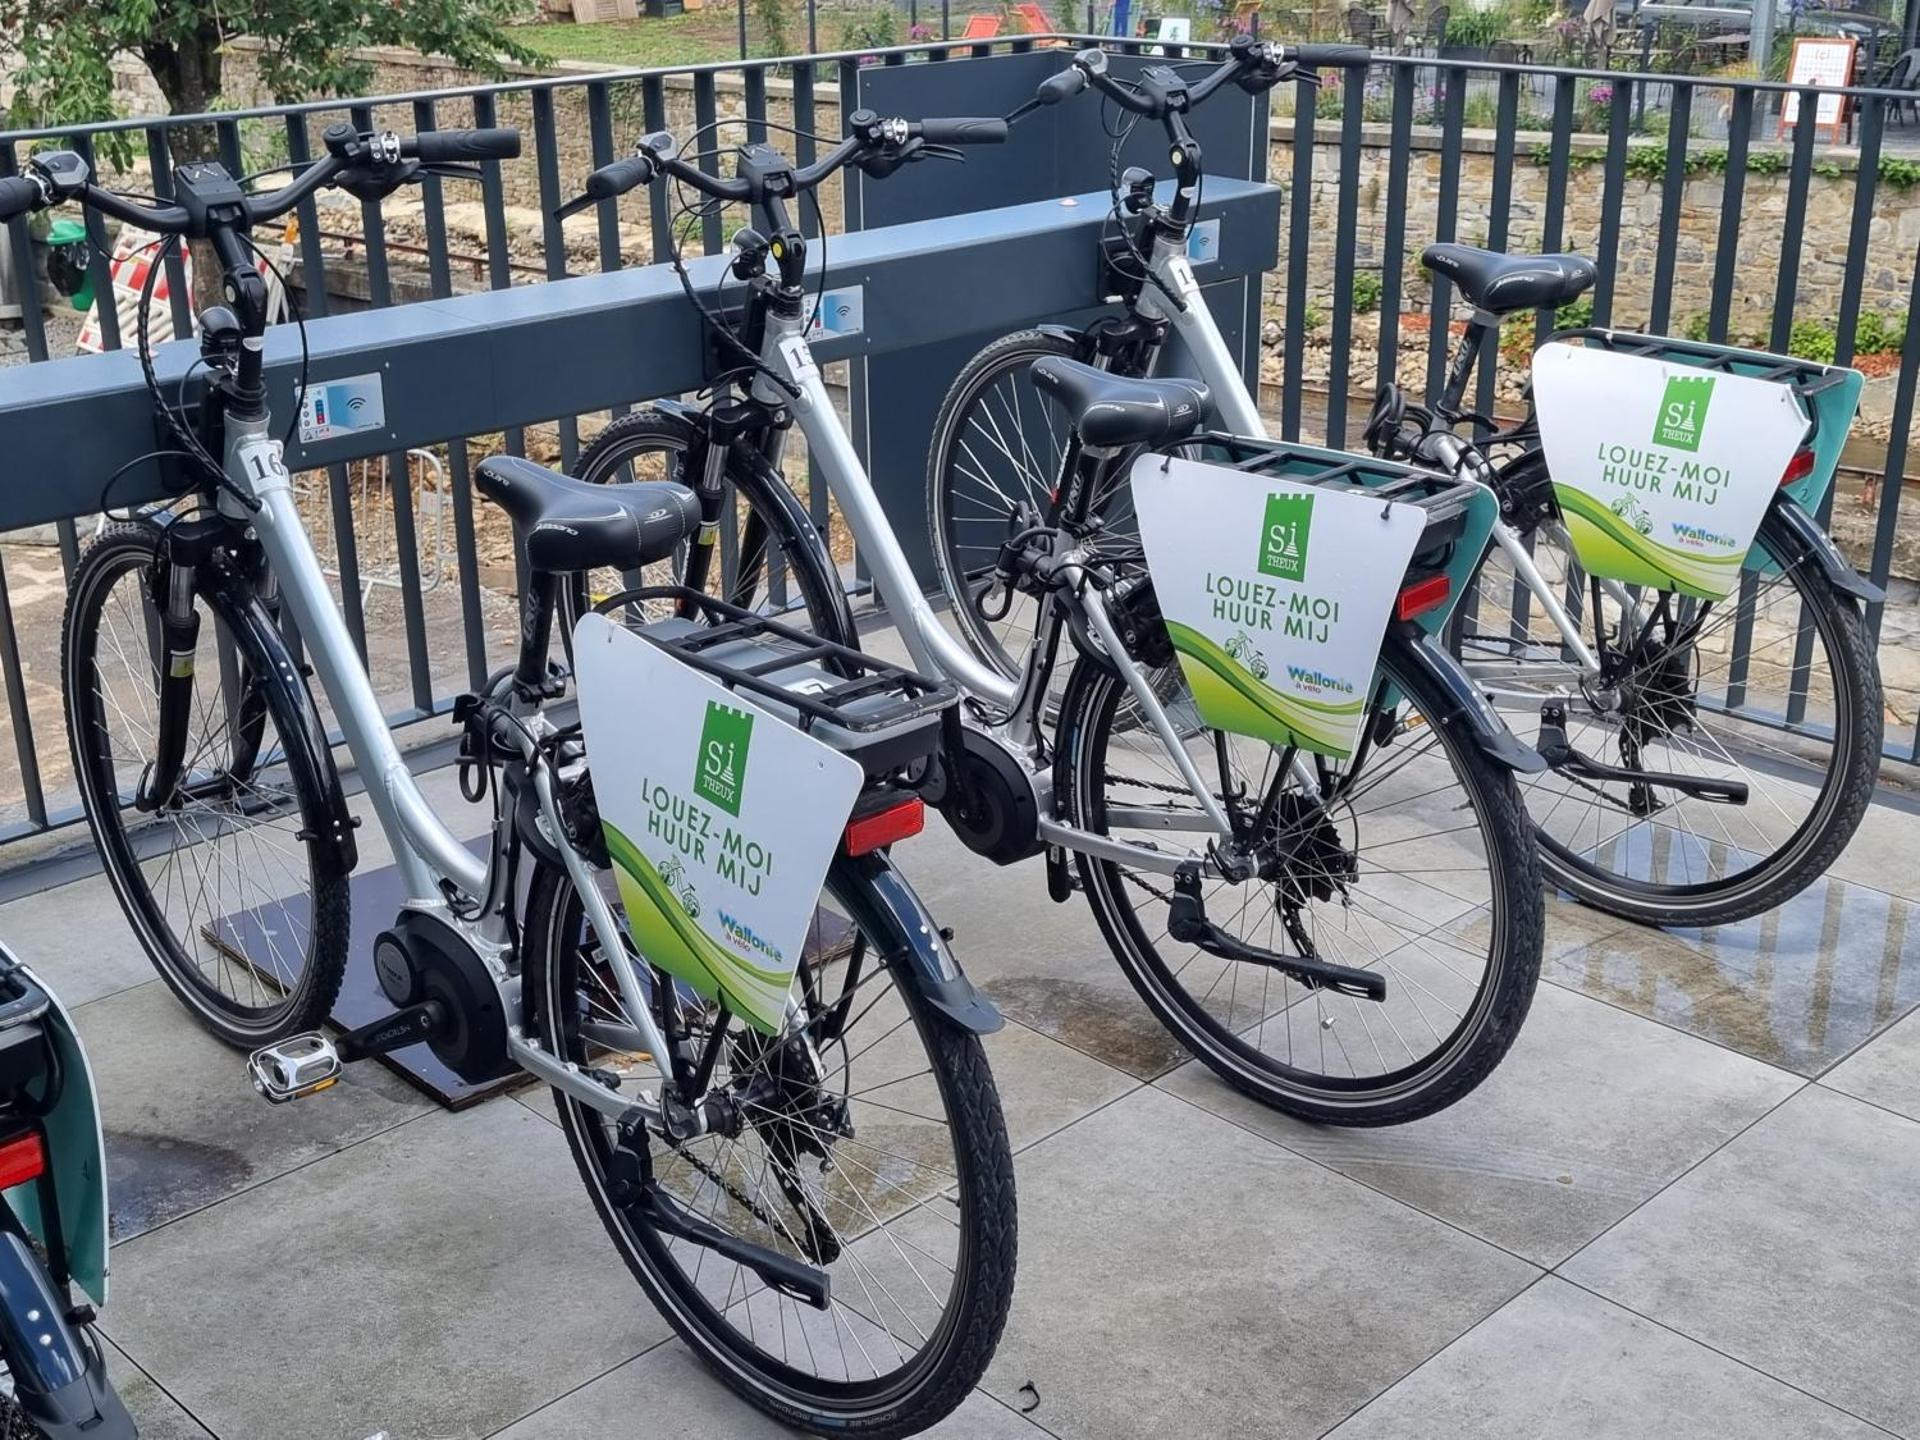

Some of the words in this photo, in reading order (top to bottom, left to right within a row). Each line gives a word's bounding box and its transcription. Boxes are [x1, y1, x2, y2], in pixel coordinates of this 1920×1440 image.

[1662, 427, 1694, 444] THEUX
[250, 453, 284, 480] 16
[1598, 442, 1730, 488] LOUEZ-MOI
[1602, 465, 1661, 493] HUUR
[1672, 481, 1717, 505] MIJ
[1672, 522, 1736, 548] Wallonie
[1267, 555, 1299, 572] THEUX
[1206, 573, 1339, 622] LOUEZ-MOI
[1213, 598, 1272, 630] HUUR
[1284, 616, 1328, 643] MIJ
[1287, 664, 1353, 694] Wallonie
[703, 774, 735, 803] THEUX
[642, 777, 772, 877] LOUEZ-MOI
[648, 809, 706, 865] HUUR
[717, 852, 761, 896] MIJ
[718, 909, 783, 962] Wallonie
